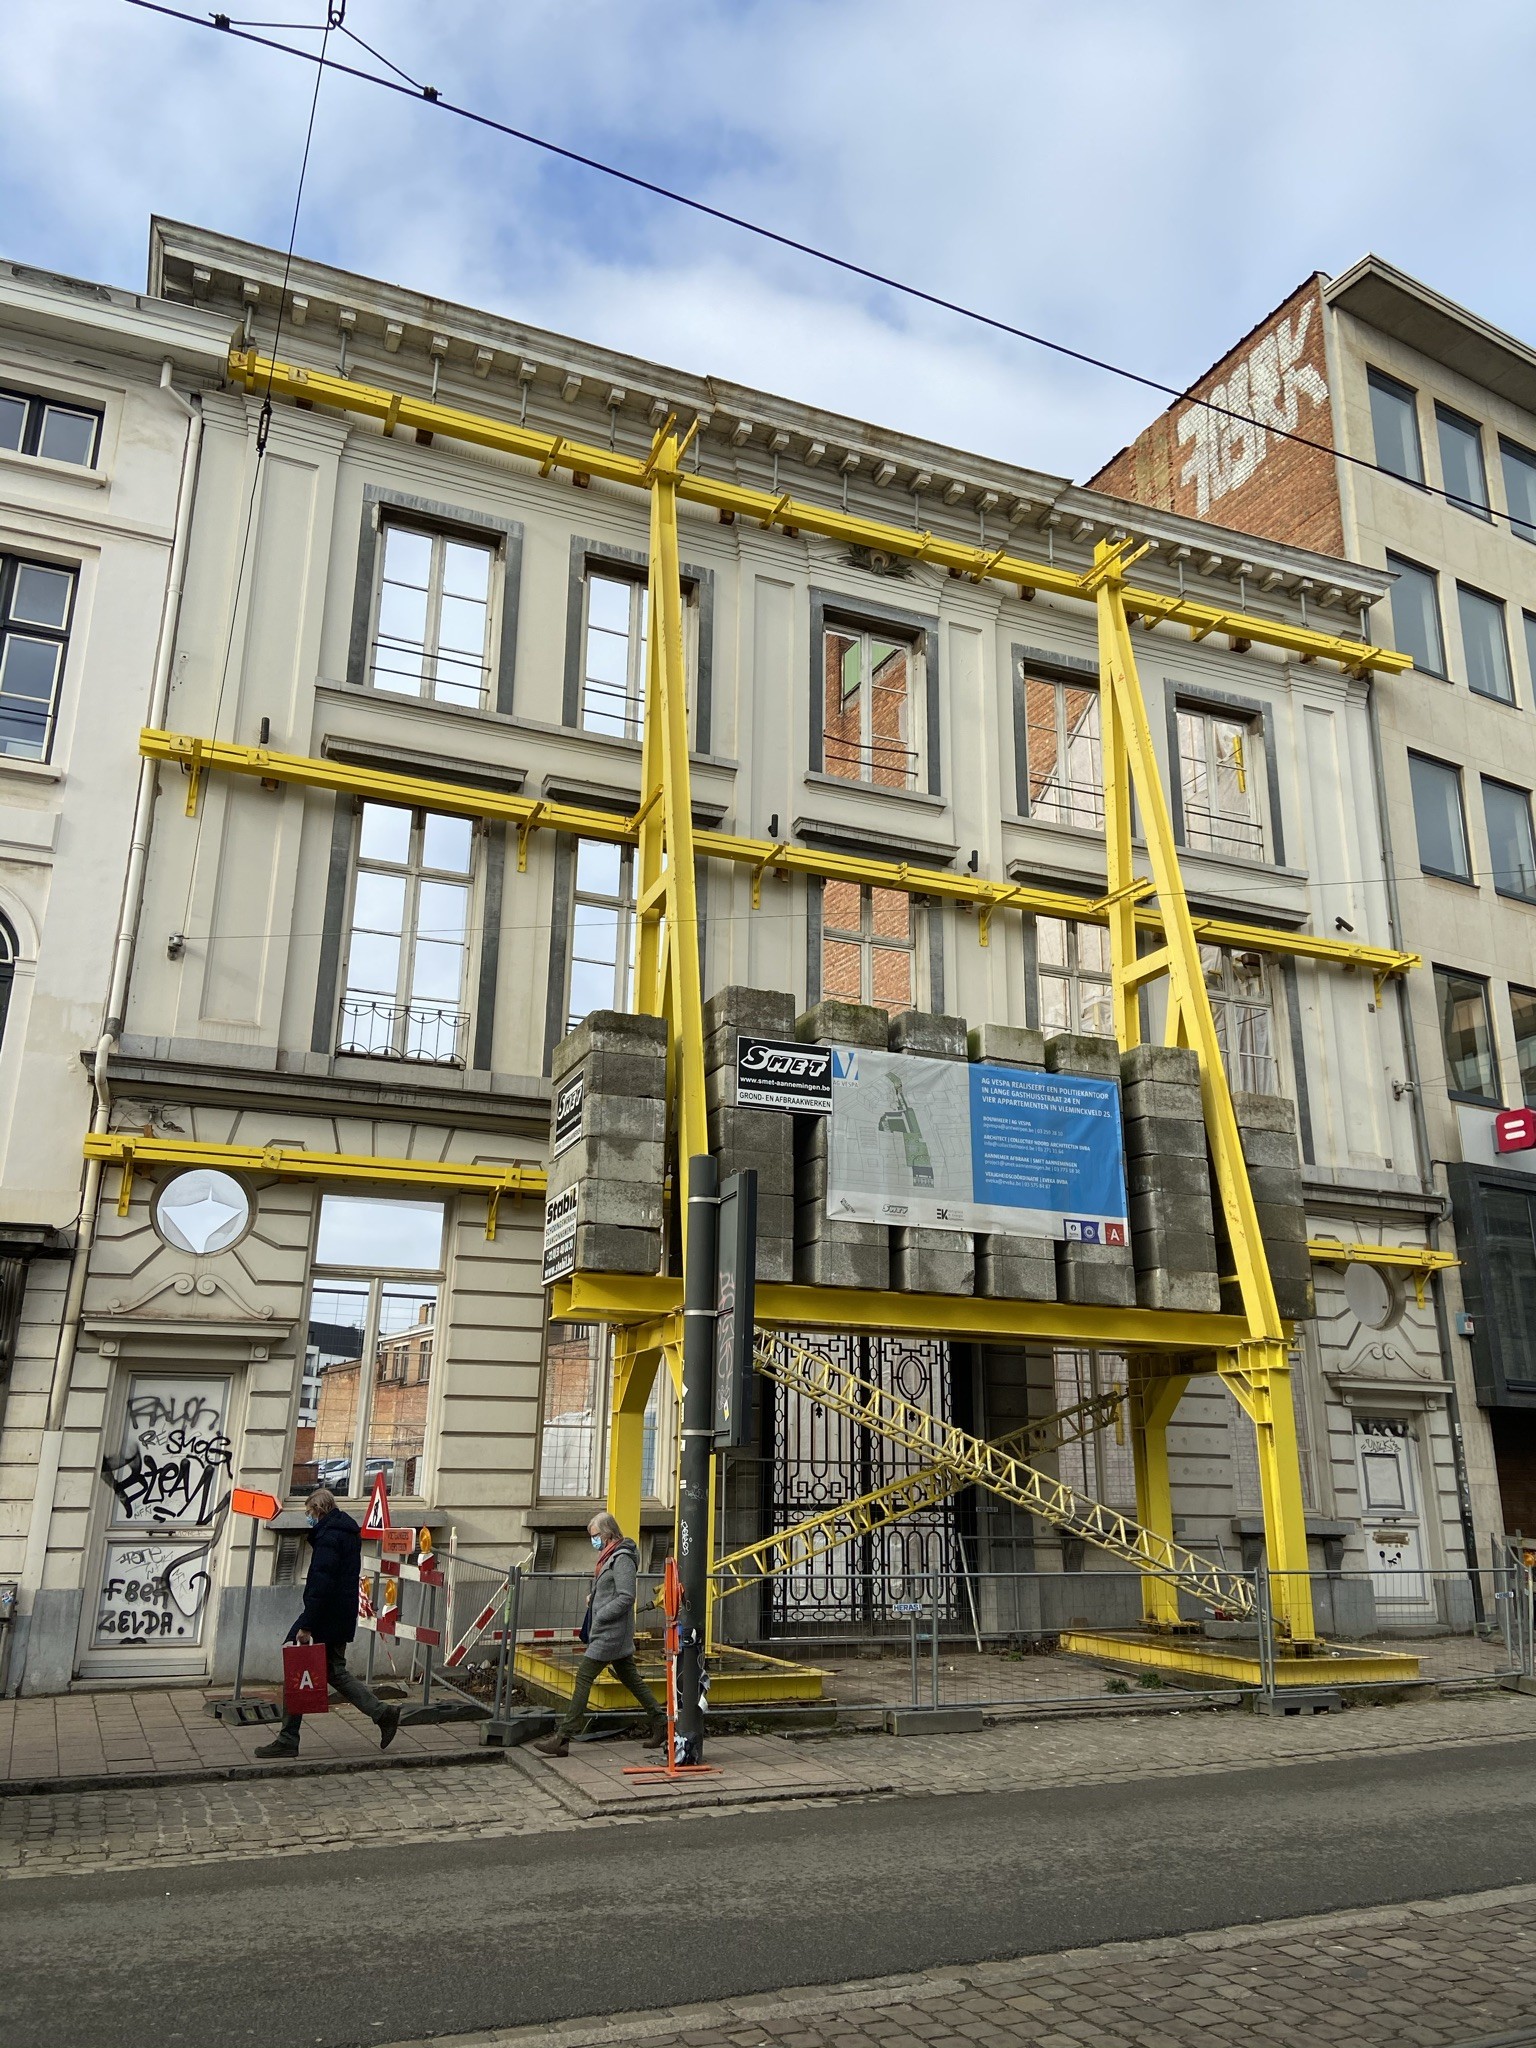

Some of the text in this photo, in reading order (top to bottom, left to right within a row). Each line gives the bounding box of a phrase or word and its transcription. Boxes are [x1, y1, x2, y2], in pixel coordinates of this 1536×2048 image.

[740, 1045, 830, 1077] SMET
[740, 1076, 831, 1092] www.smet-aannemingen.be
[981, 1077, 1110, 1100] AG VESPA REALISEERT EEN POLITIEKANTOOR
[739, 1091, 831, 1108] GROND- EN AFBRAAKWERKEN
[982, 1095, 996, 1104] VIER
[997, 1097, 1049, 1110] APPARTEMENTEN
[1058, 1105, 1103, 1117] VLEMINCKVELD
[990, 1088, 1010, 1097] LANGE
[1011, 1091, 1062, 1103] GASTHUISSTRAAT
[1072, 1098, 1081, 1106] EN
[984, 1134, 1007, 1142] ARCHITECT
[1110, 1228, 1120, 1241] A
[299, 1670, 314, 1690] A
